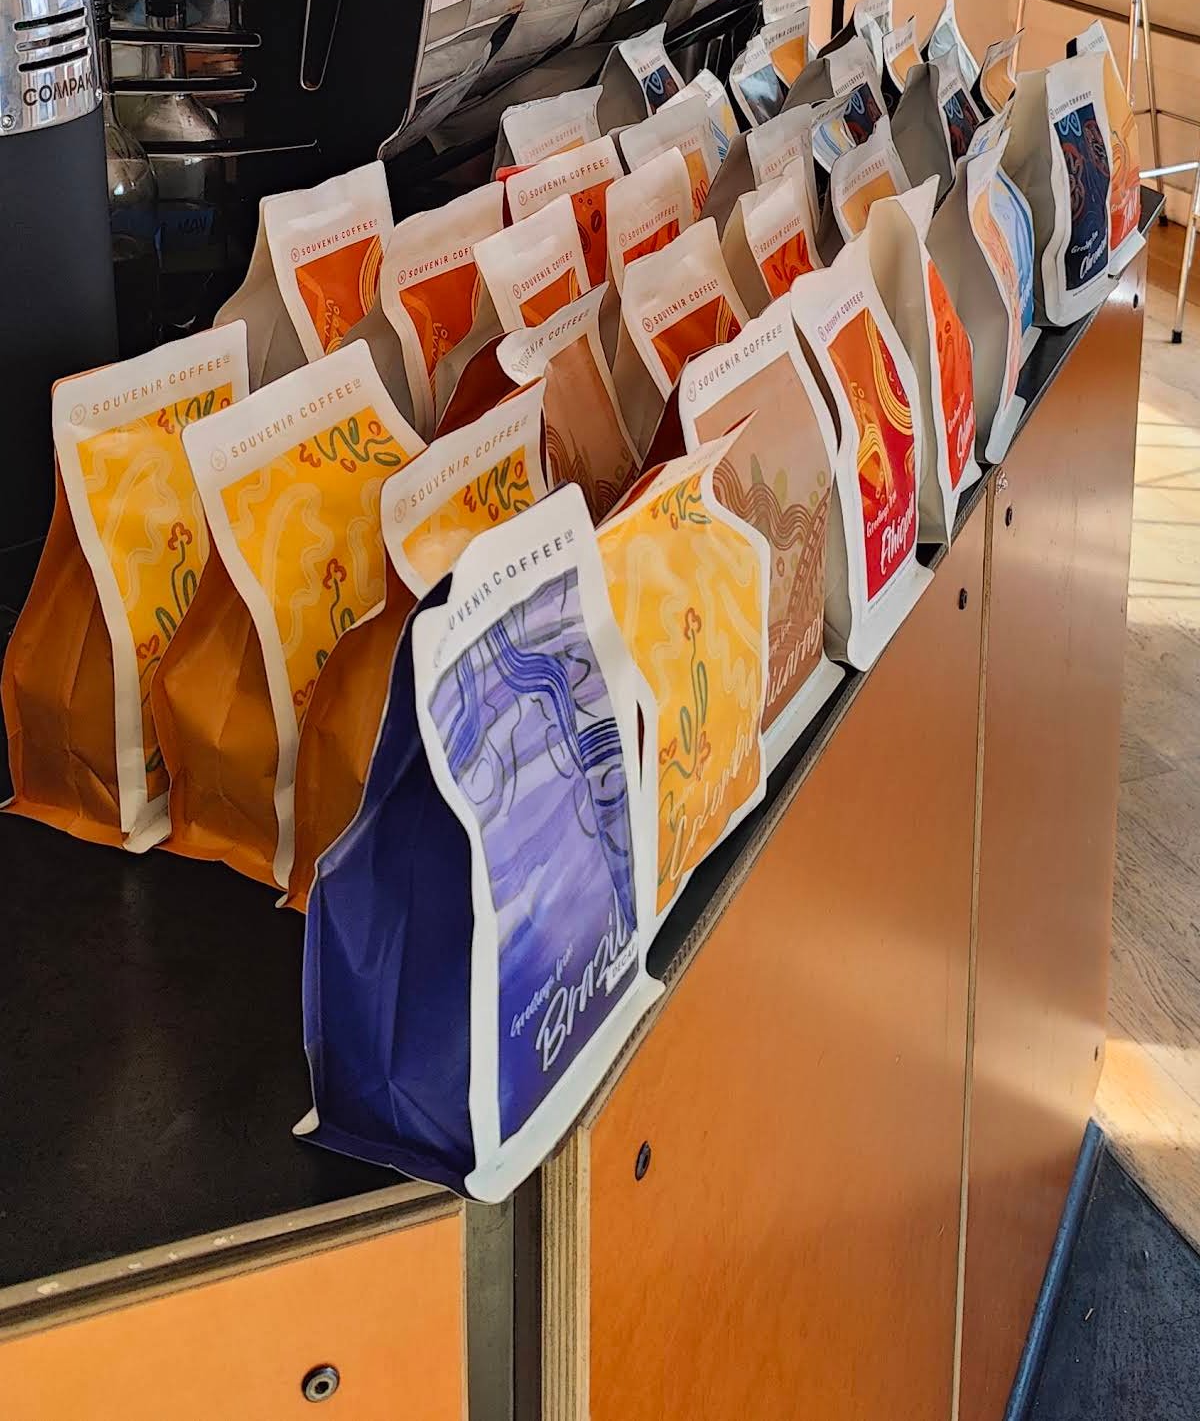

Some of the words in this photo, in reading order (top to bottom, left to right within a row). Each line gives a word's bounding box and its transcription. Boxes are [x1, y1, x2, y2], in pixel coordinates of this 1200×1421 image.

[23, 72, 92, 107] COMPAK
[529, 175, 567, 199] SOUVENIR
[569, 159, 605, 179] COFFEE
[301, 234, 339, 256] SOUVENIR
[341, 220, 374, 239] COFFEE
[408, 252, 449, 279] SOUVENIR
[521, 267, 551, 293] SOUVENIR
[653, 299, 686, 325] SOUVENIR
[688, 280, 717, 302] COFFEE
[548, 312, 585, 340] COFFEE
[699, 353, 741, 391] SOUVENIR
[743, 329, 777, 358] COFFEE
[92, 379, 163, 416] SOUVENIR
[169, 357, 222, 385] COFFEE
[231, 414, 295, 459] SOUVENIR
[300, 383, 353, 419] COFFEE
[411, 455, 470, 507] SOUVENIR
[475, 421, 519, 459] COFFEE
[493, 537, 563, 586] COFFEE
